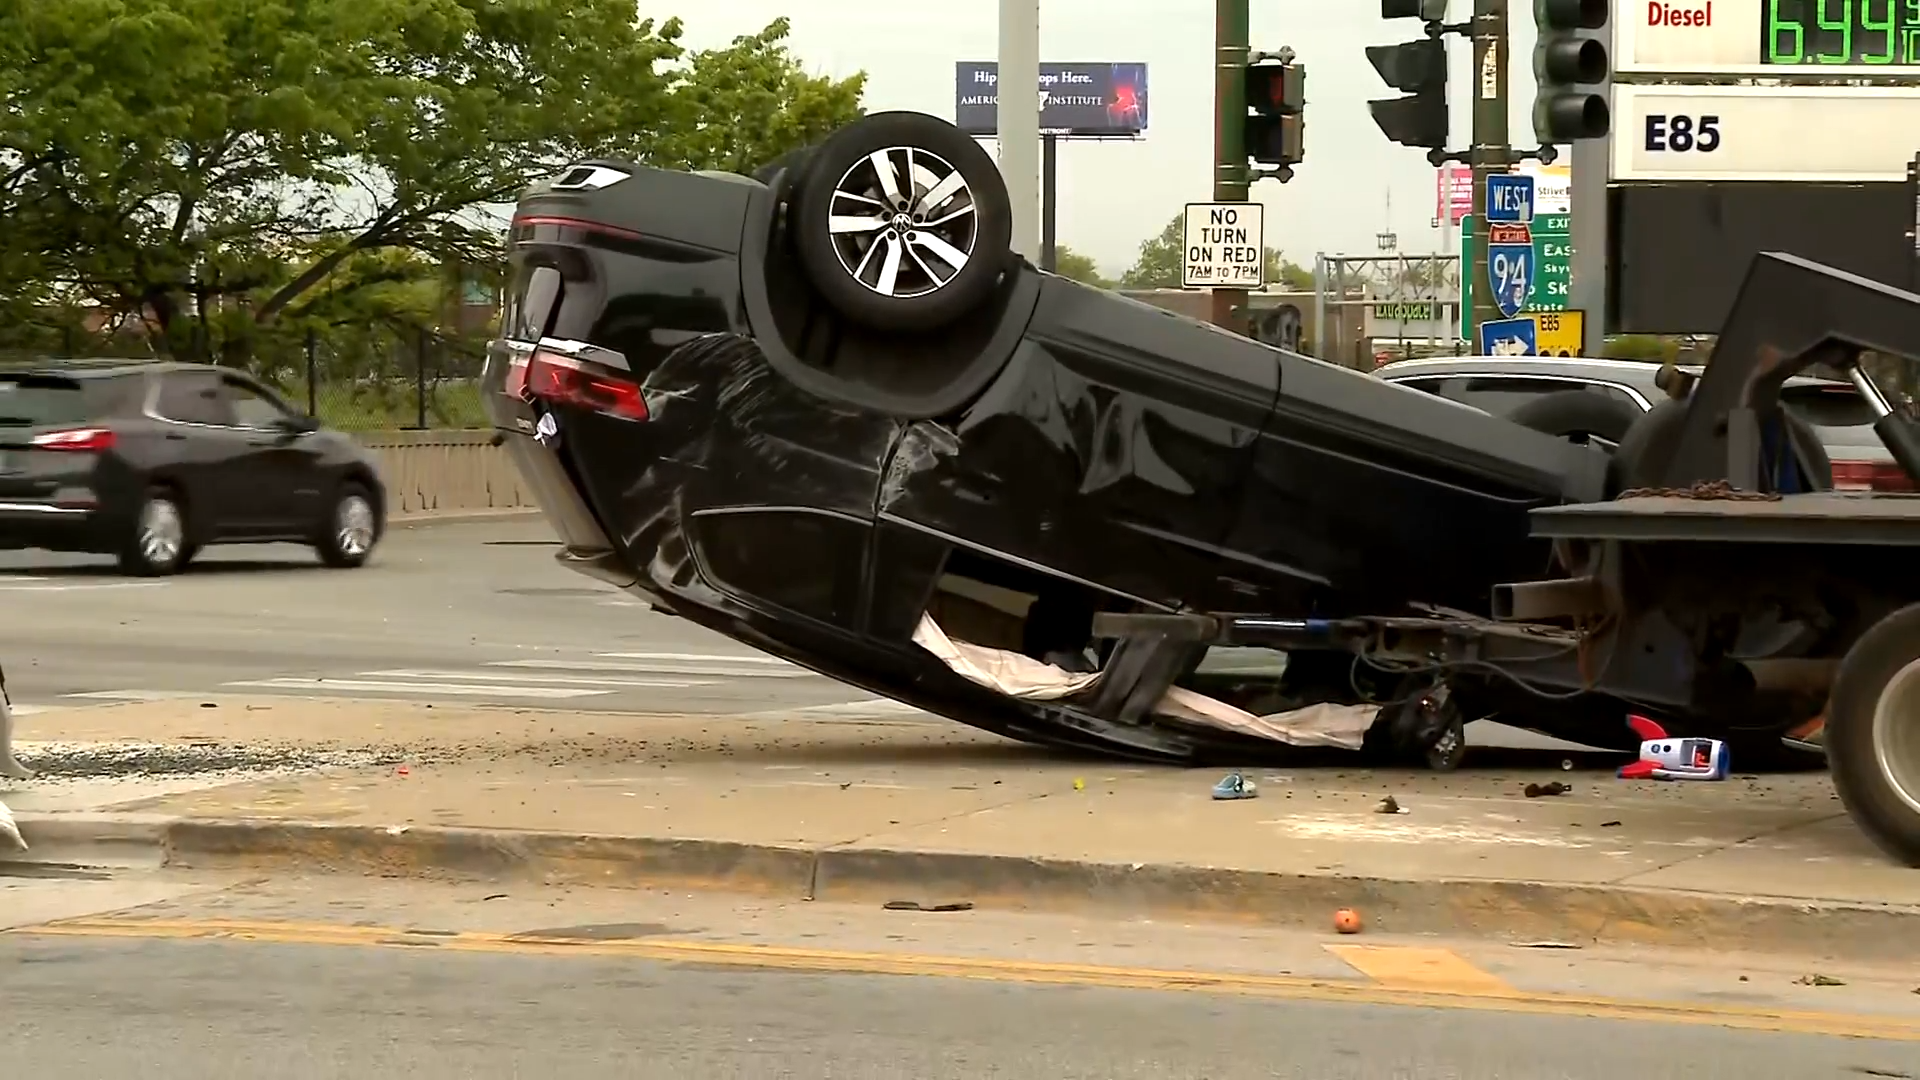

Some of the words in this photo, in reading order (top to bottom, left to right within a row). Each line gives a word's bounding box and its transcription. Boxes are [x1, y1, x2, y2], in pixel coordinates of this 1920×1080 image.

[1648, 1, 1712, 26] Diesel
[1061, 71, 1093, 83] Here.
[1048, 96, 1103, 106] INSTITUTE
[1645, 115, 1720, 152] E85
[1493, 185, 1529, 211] WEST
[1211, 209, 1237, 225] NO
[1201, 228, 1246, 244] TURN
[1190, 246, 1212, 262] ON
[1223, 247, 1257, 262] RED
[1187, 265, 1212, 278] 7AM
[1216, 267, 1229, 278] TO
[1233, 265, 1258, 279] 7PM
[1494, 253, 1527, 303] 94
[1540, 314, 1560, 332] E85
